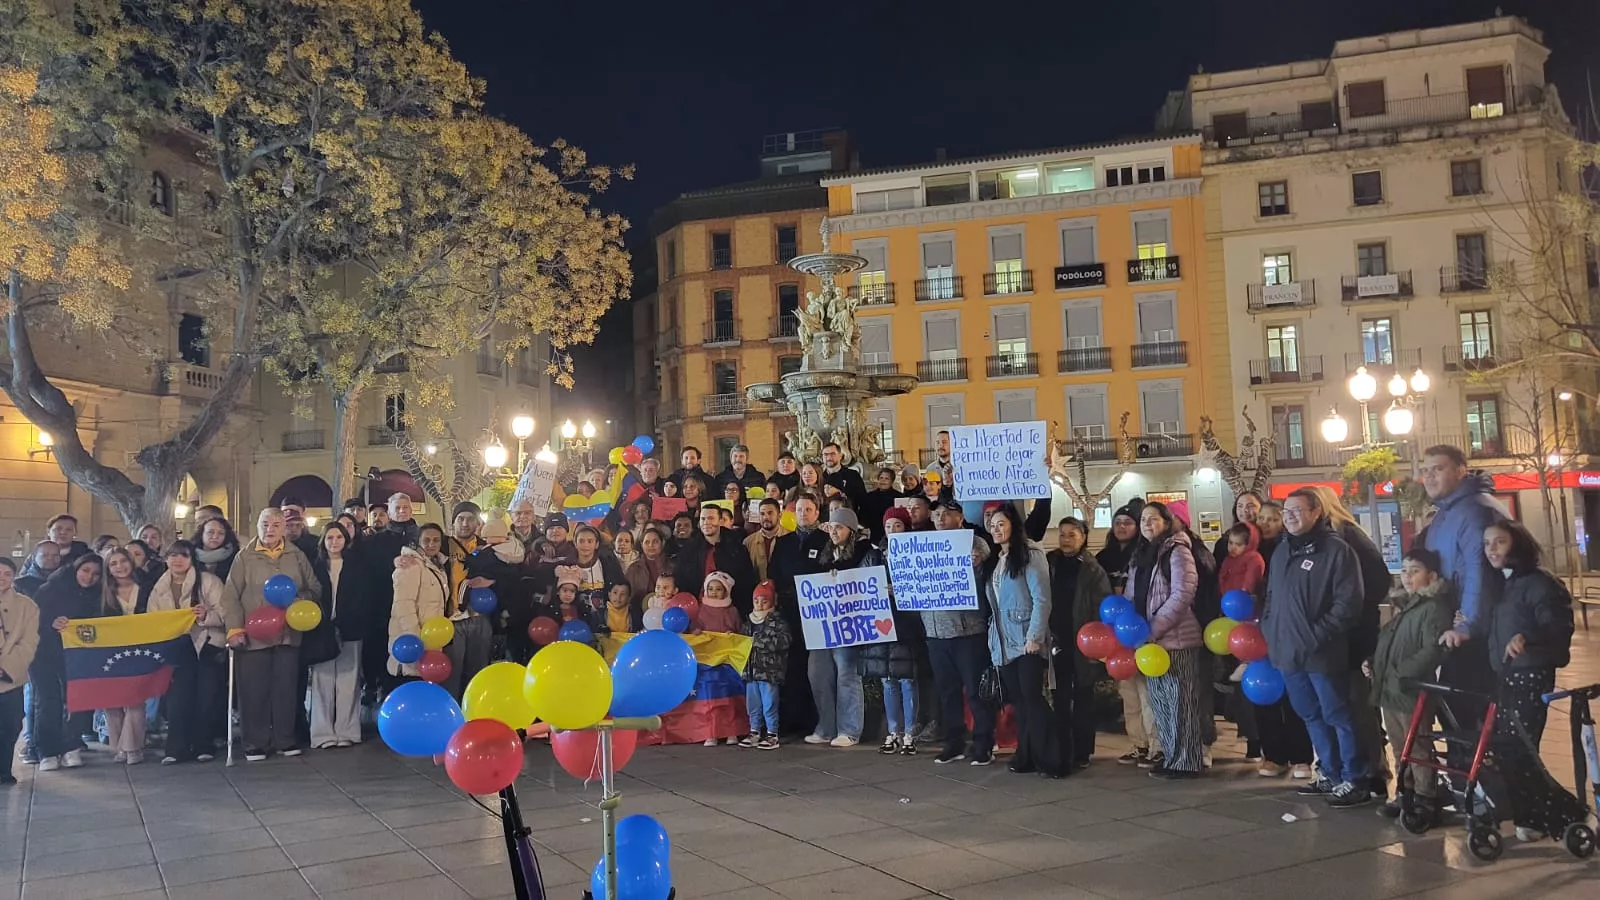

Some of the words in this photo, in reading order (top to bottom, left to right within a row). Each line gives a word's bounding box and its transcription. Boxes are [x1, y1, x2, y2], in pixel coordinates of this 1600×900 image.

[1057, 270, 1102, 280] PODÓLOGO
[952, 430, 968, 448] La
[1006, 446, 1037, 468] dejar
[955, 466, 964, 483] el
[969, 466, 1000, 481] miedo
[1002, 482, 1009, 494] el
[890, 538, 909, 557] Que
[935, 540, 952, 552] nos
[916, 556, 933, 570] Que
[956, 555, 971, 566] nos
[952, 568, 967, 579] nos
[801, 576, 878, 601] Queremos
[802, 602, 828, 619] UNA
[827, 594, 889, 618] Venezuela
[821, 615, 880, 648] LIBRE
